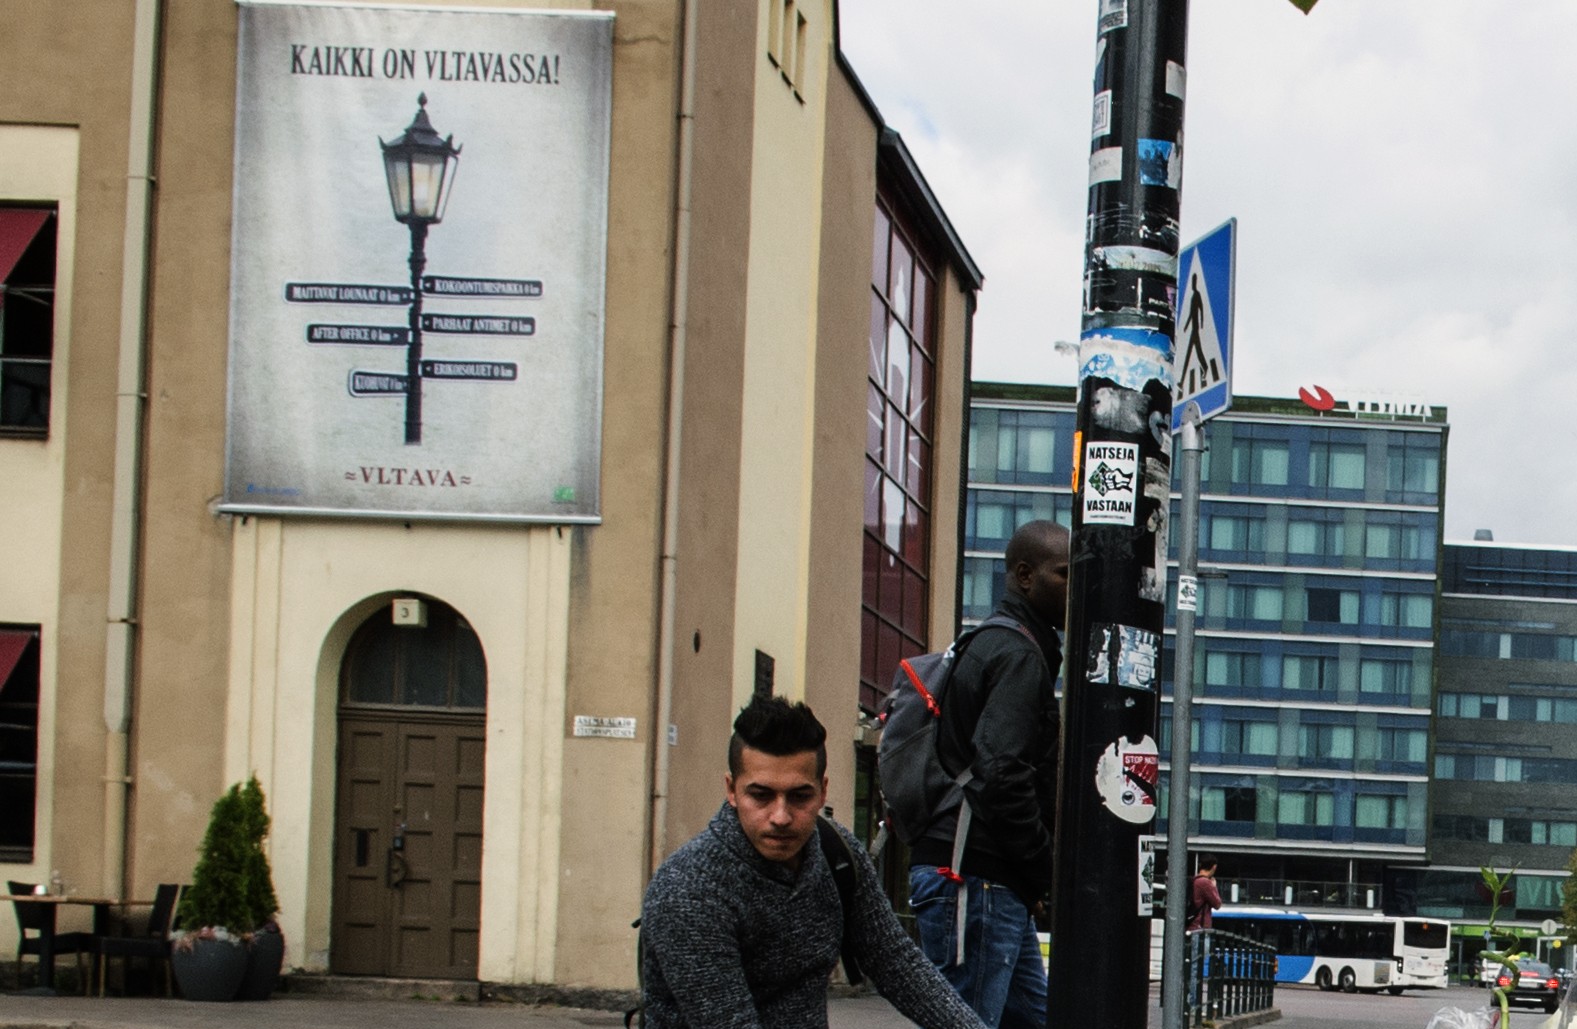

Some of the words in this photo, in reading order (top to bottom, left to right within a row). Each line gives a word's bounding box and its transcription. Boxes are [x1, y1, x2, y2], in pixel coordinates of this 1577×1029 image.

[291, 44, 374, 78] KAIKKI
[382, 48, 416, 79] ON
[425, 50, 560, 85] VLTAVASSA!
[339, 287, 378, 301] LOUNAAT
[387, 289, 400, 302] km
[432, 317, 472, 331] PARHAAT
[511, 320, 518, 332] 0
[518, 320, 532, 333] km
[312, 327, 339, 340] AFTER
[340, 328, 370, 340] OFFICE
[378, 329, 391, 341] km
[501, 365, 514, 378] km
[1089, 446, 1135, 461] NATSEJA
[359, 466, 458, 487] VLTAVA
[1086, 499, 1132, 514] VASTAAN
[401, 607, 410, 618] 3
[1125, 755, 1143, 764] STOP
